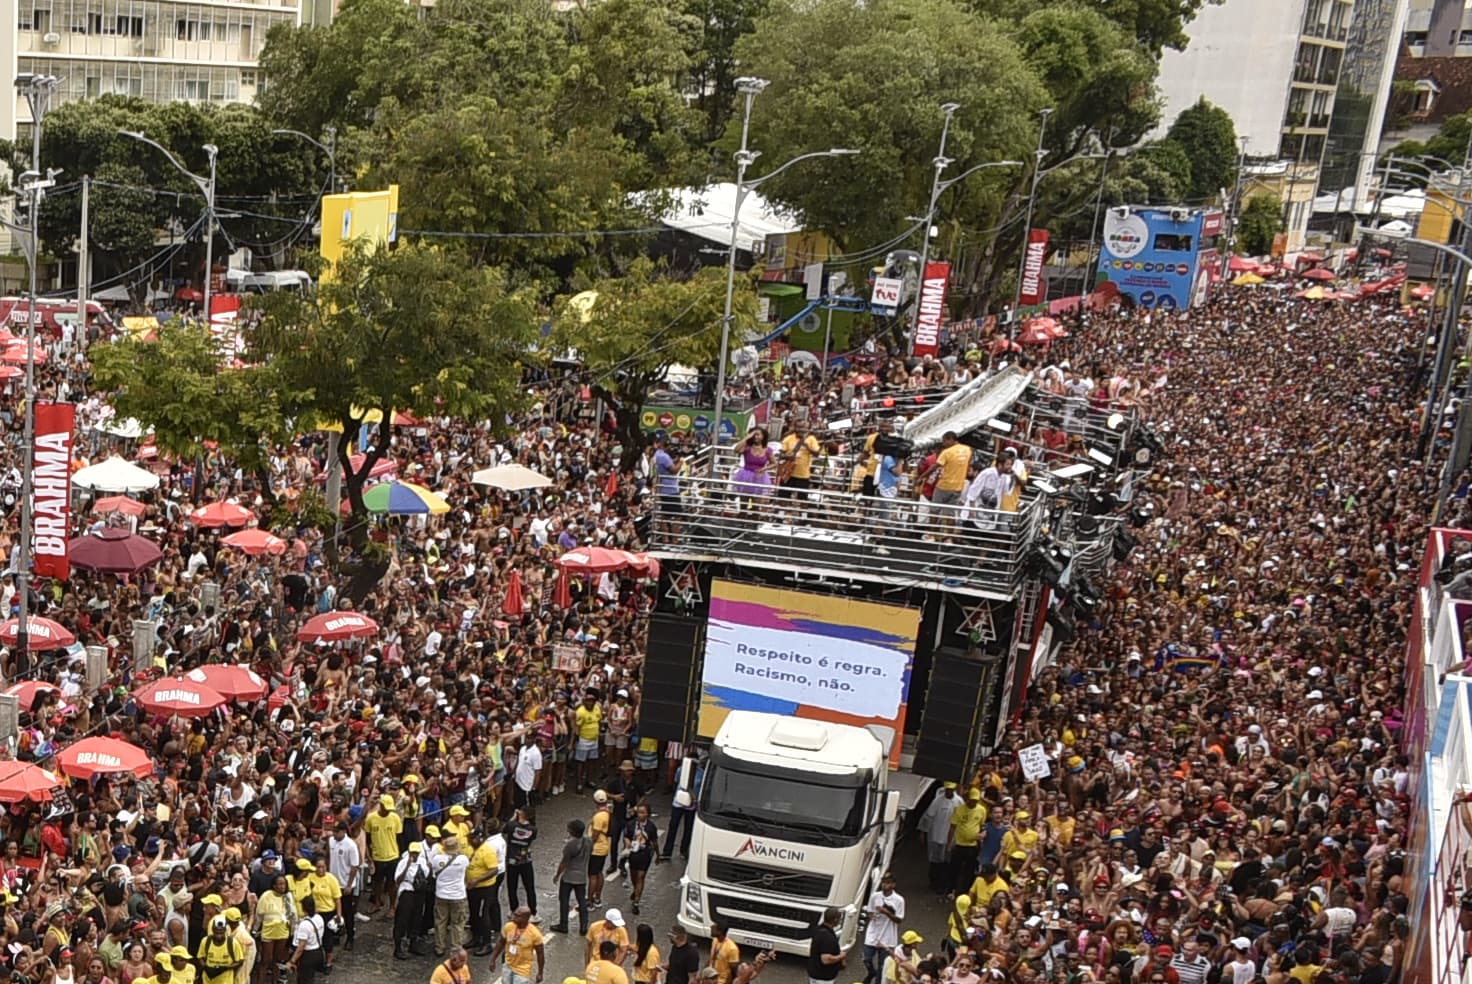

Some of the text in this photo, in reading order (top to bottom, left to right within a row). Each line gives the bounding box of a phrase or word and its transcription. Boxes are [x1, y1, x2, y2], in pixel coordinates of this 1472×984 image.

[1022, 242, 1046, 296] BRAHMA
[916, 278, 946, 346] BRAHMA
[36, 432, 70, 557] BRAHMA
[325, 616, 366, 632] BRAHMA
[736, 642, 888, 678] Respeito é regra.
[734, 662, 856, 693] Racismo, não.
[155, 690, 200, 705] BRAHMA
[77, 752, 122, 767] BRAHMA
[734, 836, 805, 862] AVANCINI
